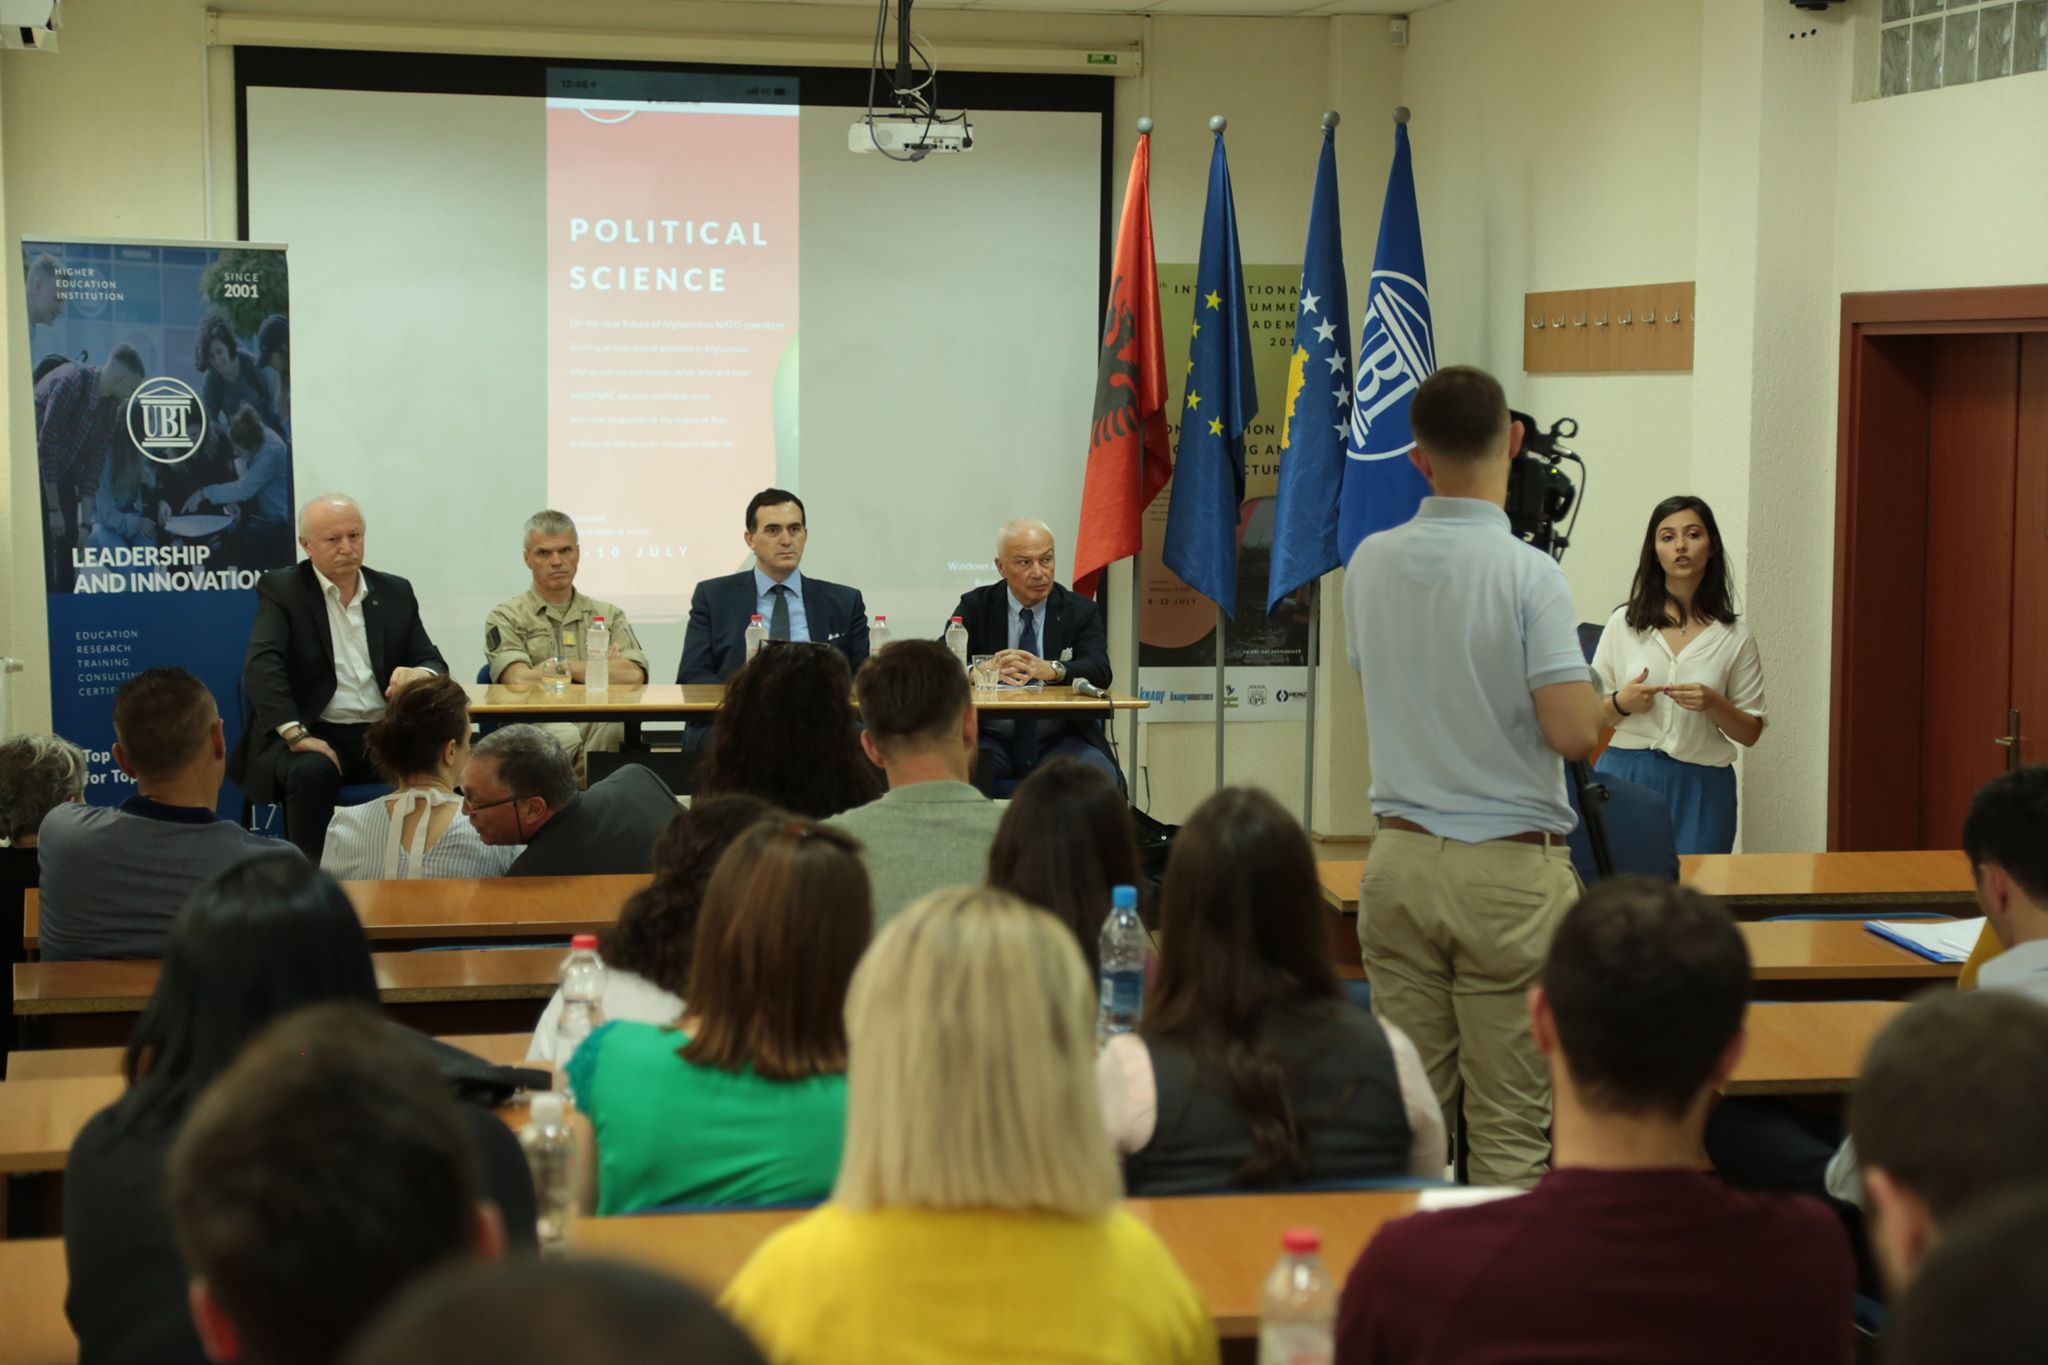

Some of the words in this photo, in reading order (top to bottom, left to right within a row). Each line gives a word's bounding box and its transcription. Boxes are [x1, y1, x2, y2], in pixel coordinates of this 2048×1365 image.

[569, 218, 768, 246] POLITICAL
[54, 267, 95, 277] HIGHER
[223, 271, 259, 283] SINCE
[55, 279, 117, 290] EDUCATION
[569, 266, 726, 292] SCIENCE
[56, 291, 125, 301] INSTITUTION
[223, 283, 259, 299] 2001
[1250, 303, 1296, 312] UMME
[1252, 320, 1296, 329] ADEM
[1269, 337, 1296, 347] 201
[141, 405, 192, 438] UBT
[72, 545, 211, 568] LEADERSHIP
[637, 545, 688, 558] JULY
[73, 572, 126, 595] AND
[76, 630, 139, 641] EDUCATION
[77, 644, 132, 654] RESEARCH
[78, 658, 129, 668] TRAINING
[78, 671, 144, 682] CONSULTIN
[83, 749, 111, 764] Top
[249, 803, 277, 831] 17
